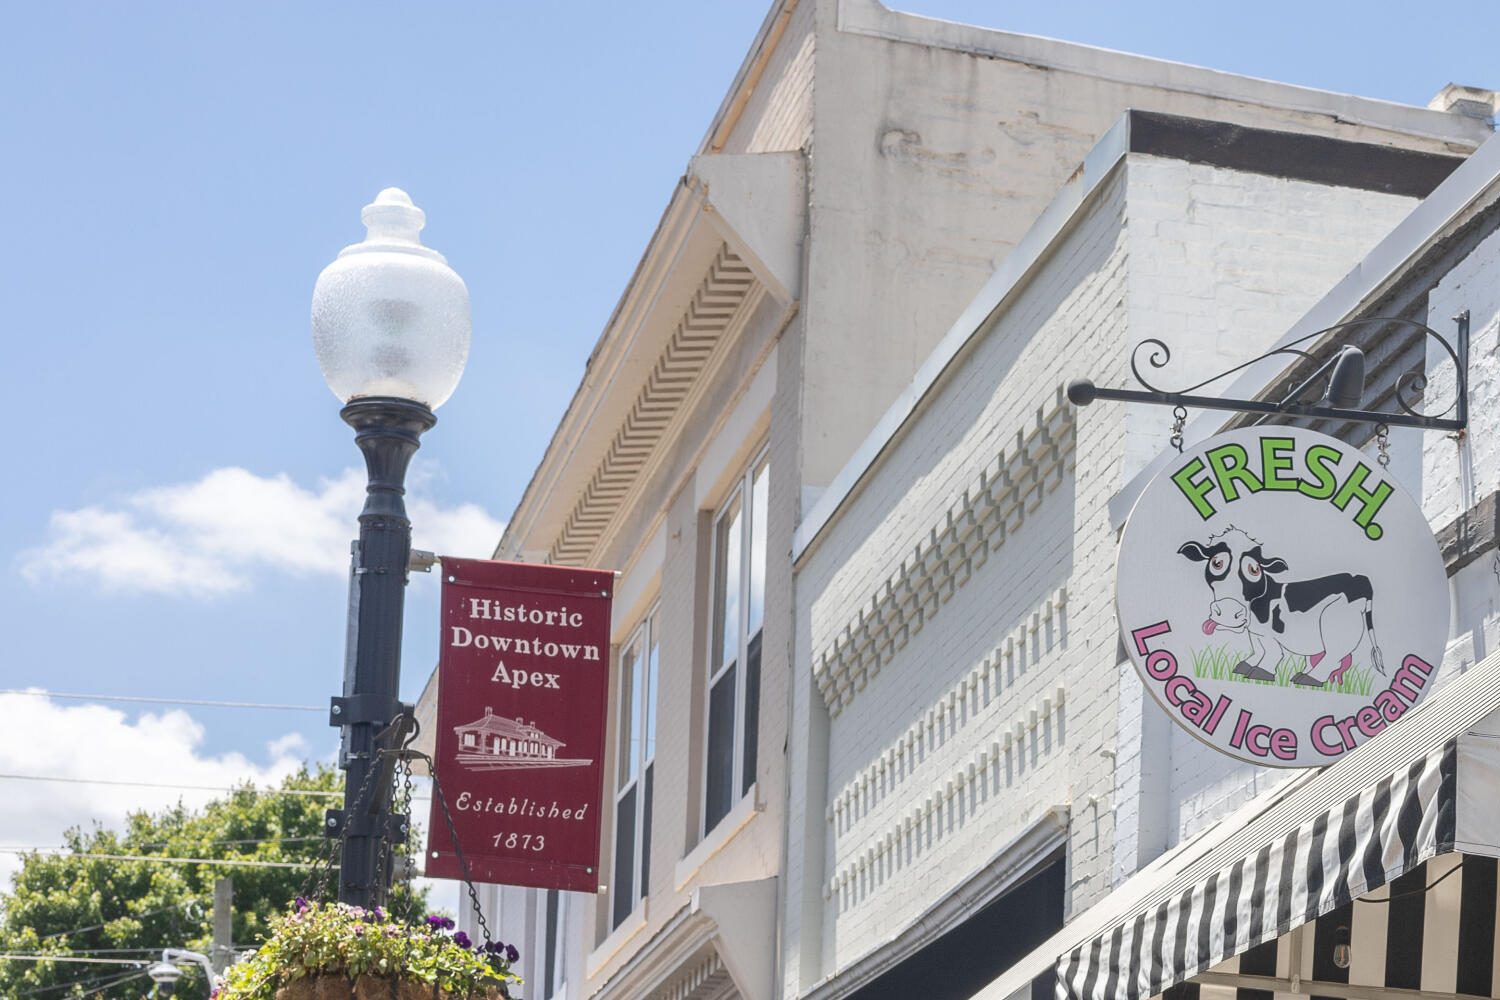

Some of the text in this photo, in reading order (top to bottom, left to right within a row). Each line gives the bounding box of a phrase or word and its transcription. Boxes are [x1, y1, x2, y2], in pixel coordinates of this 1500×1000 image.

[469, 598, 583, 628] Historic
[451, 626, 600, 661] Downtown
[491, 660, 560, 689] Apex
[1131, 620, 1434, 760] Local Ice Cream
[456, 792, 588, 820] Established
[492, 832, 545, 851] 1873
